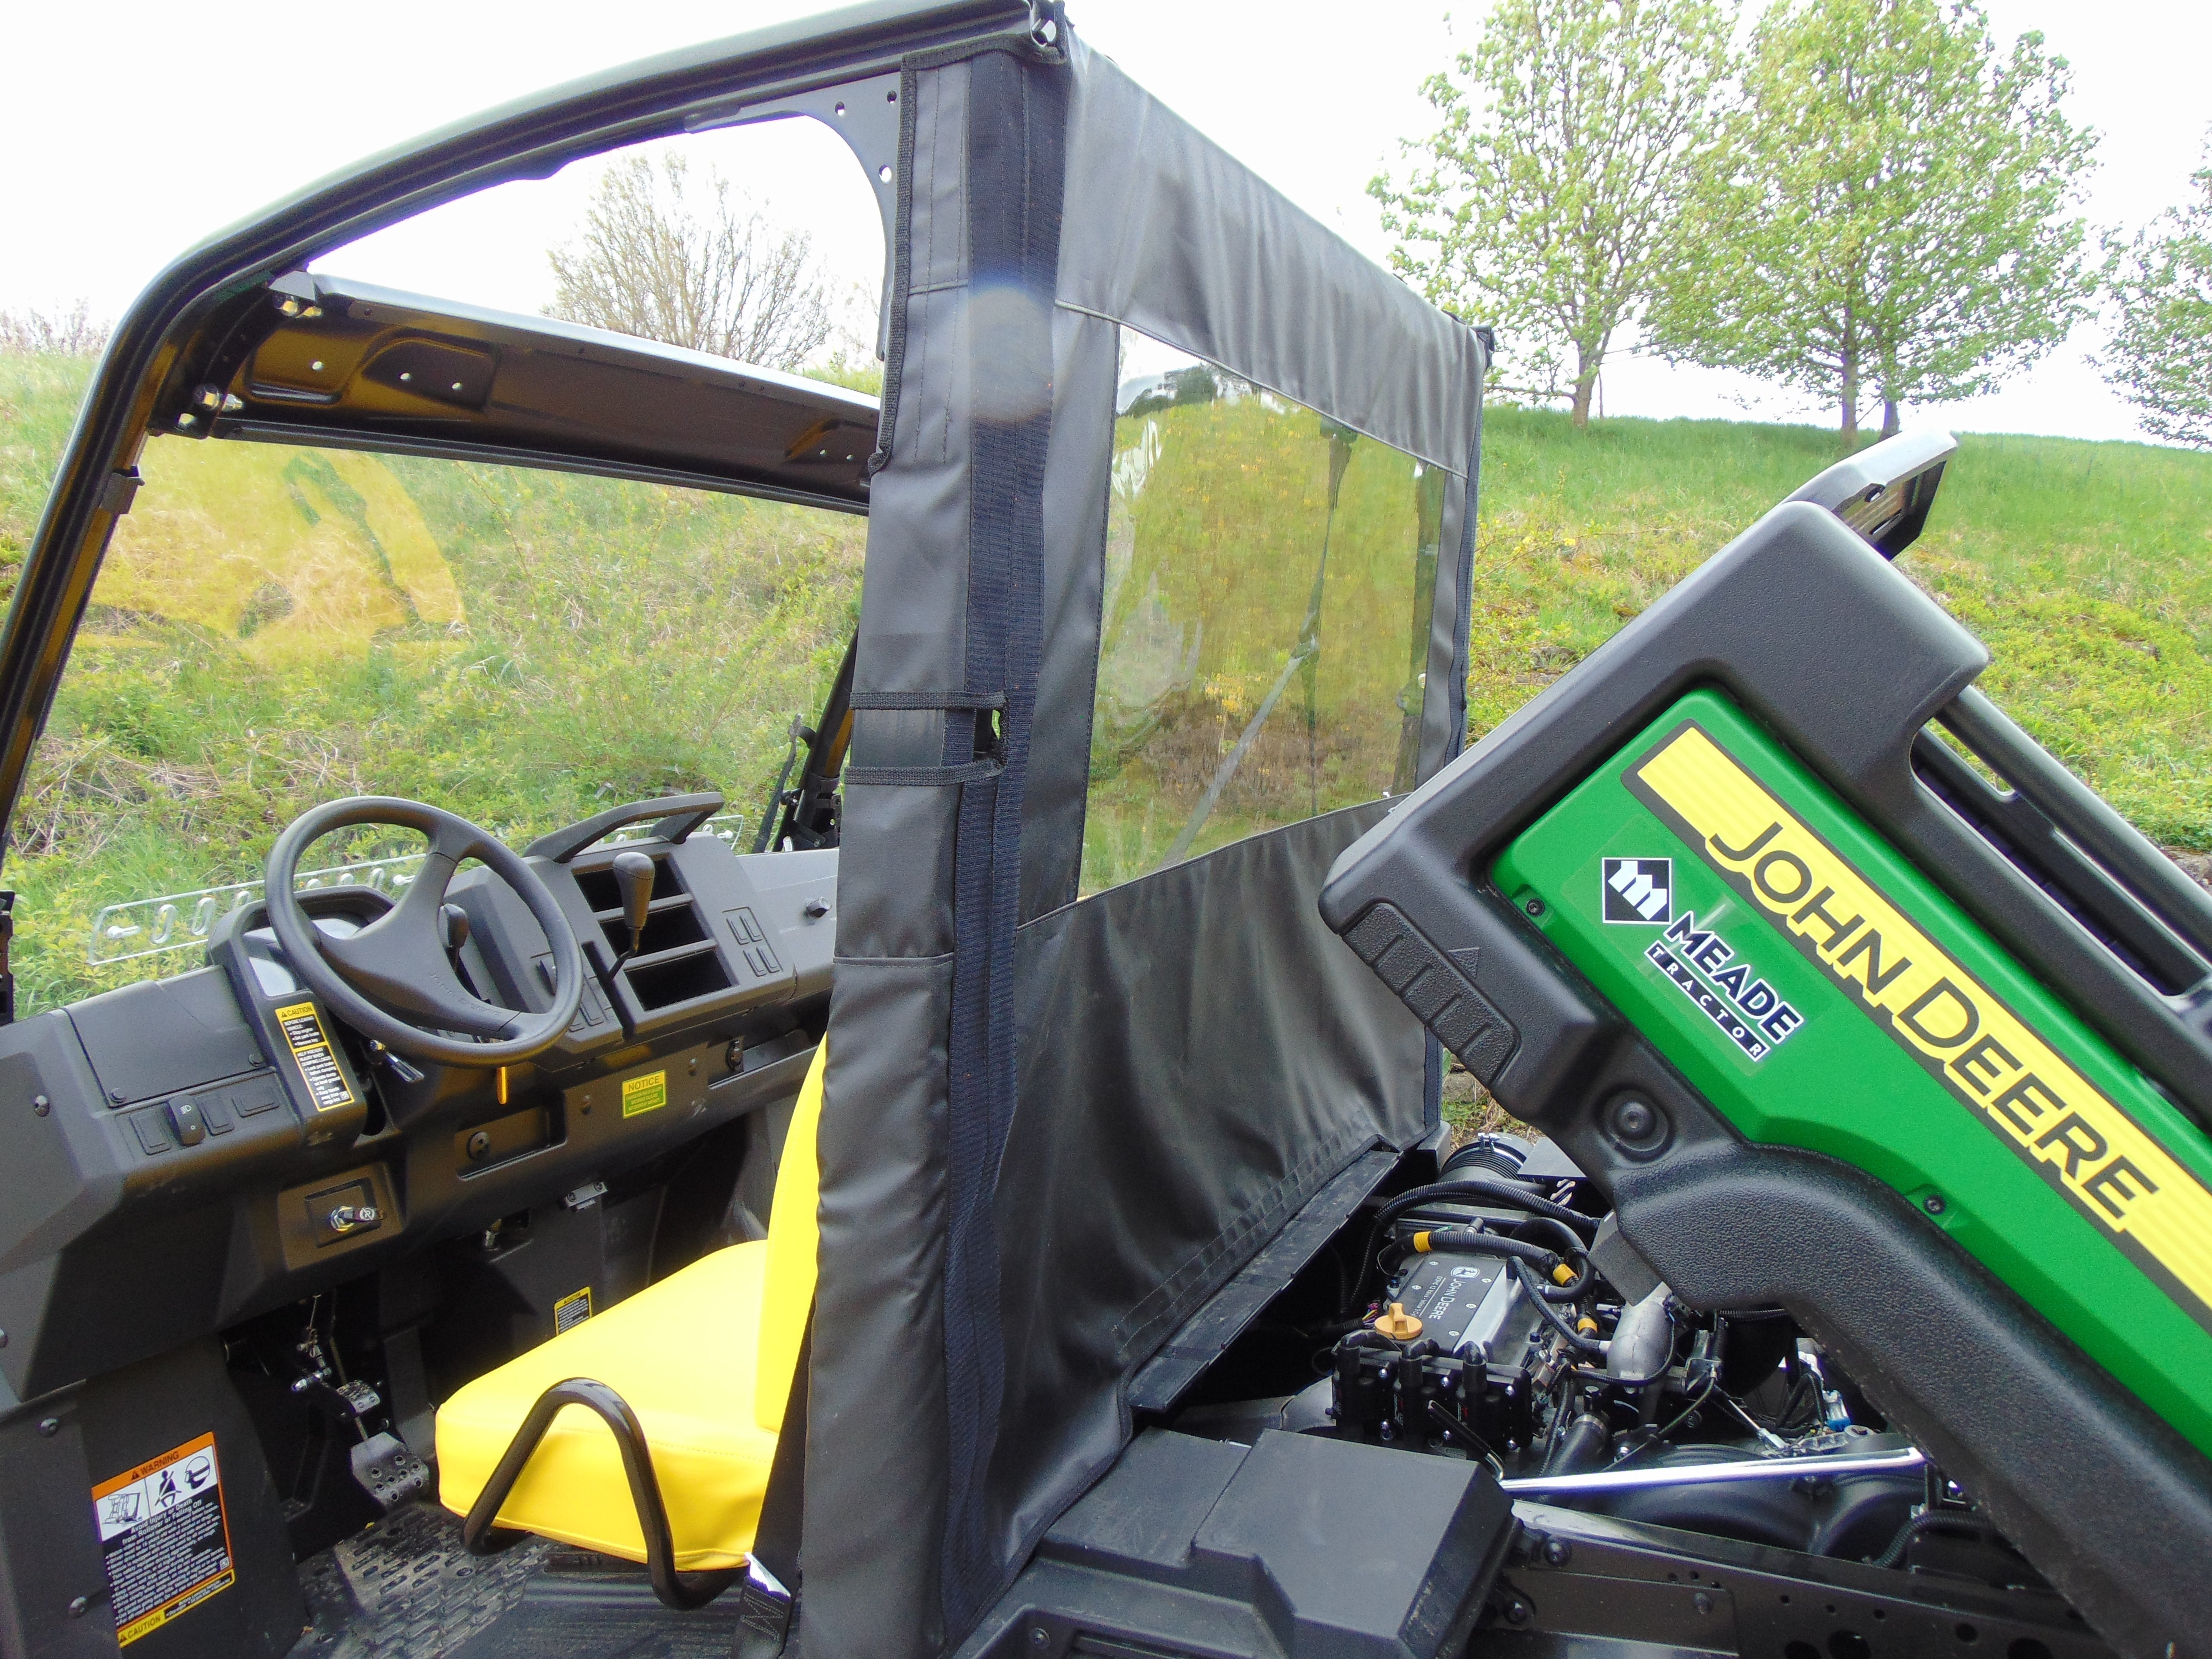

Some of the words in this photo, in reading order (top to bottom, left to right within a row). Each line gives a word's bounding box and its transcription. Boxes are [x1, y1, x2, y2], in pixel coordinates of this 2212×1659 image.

[1663, 910, 1804, 1044] MEADE
[286, 1006, 312, 1016] CAUTION
[1651, 946, 1761, 1056] TRACTOR
[1709, 821, 1912, 995] JOHN
[1897, 976, 2160, 1219] DEERE
[629, 1076, 659, 1091] NOTICE
[1443, 1278, 1466, 1296] JOHN
[1428, 1297, 1455, 1320] DEERE
[140, 1452, 179, 1476] WARNING
[122, 1533, 137, 1545] from
[138, 1519, 163, 1537] Rollover
[172, 1505, 191, 1520] Falling
[192, 1499, 202, 1508] Off
[131, 1520, 148, 1534] Avoid
[149, 1511, 167, 1525] Injury
[176, 1498, 192, 1510] Death
[128, 1615, 161, 1638] CAUTION
